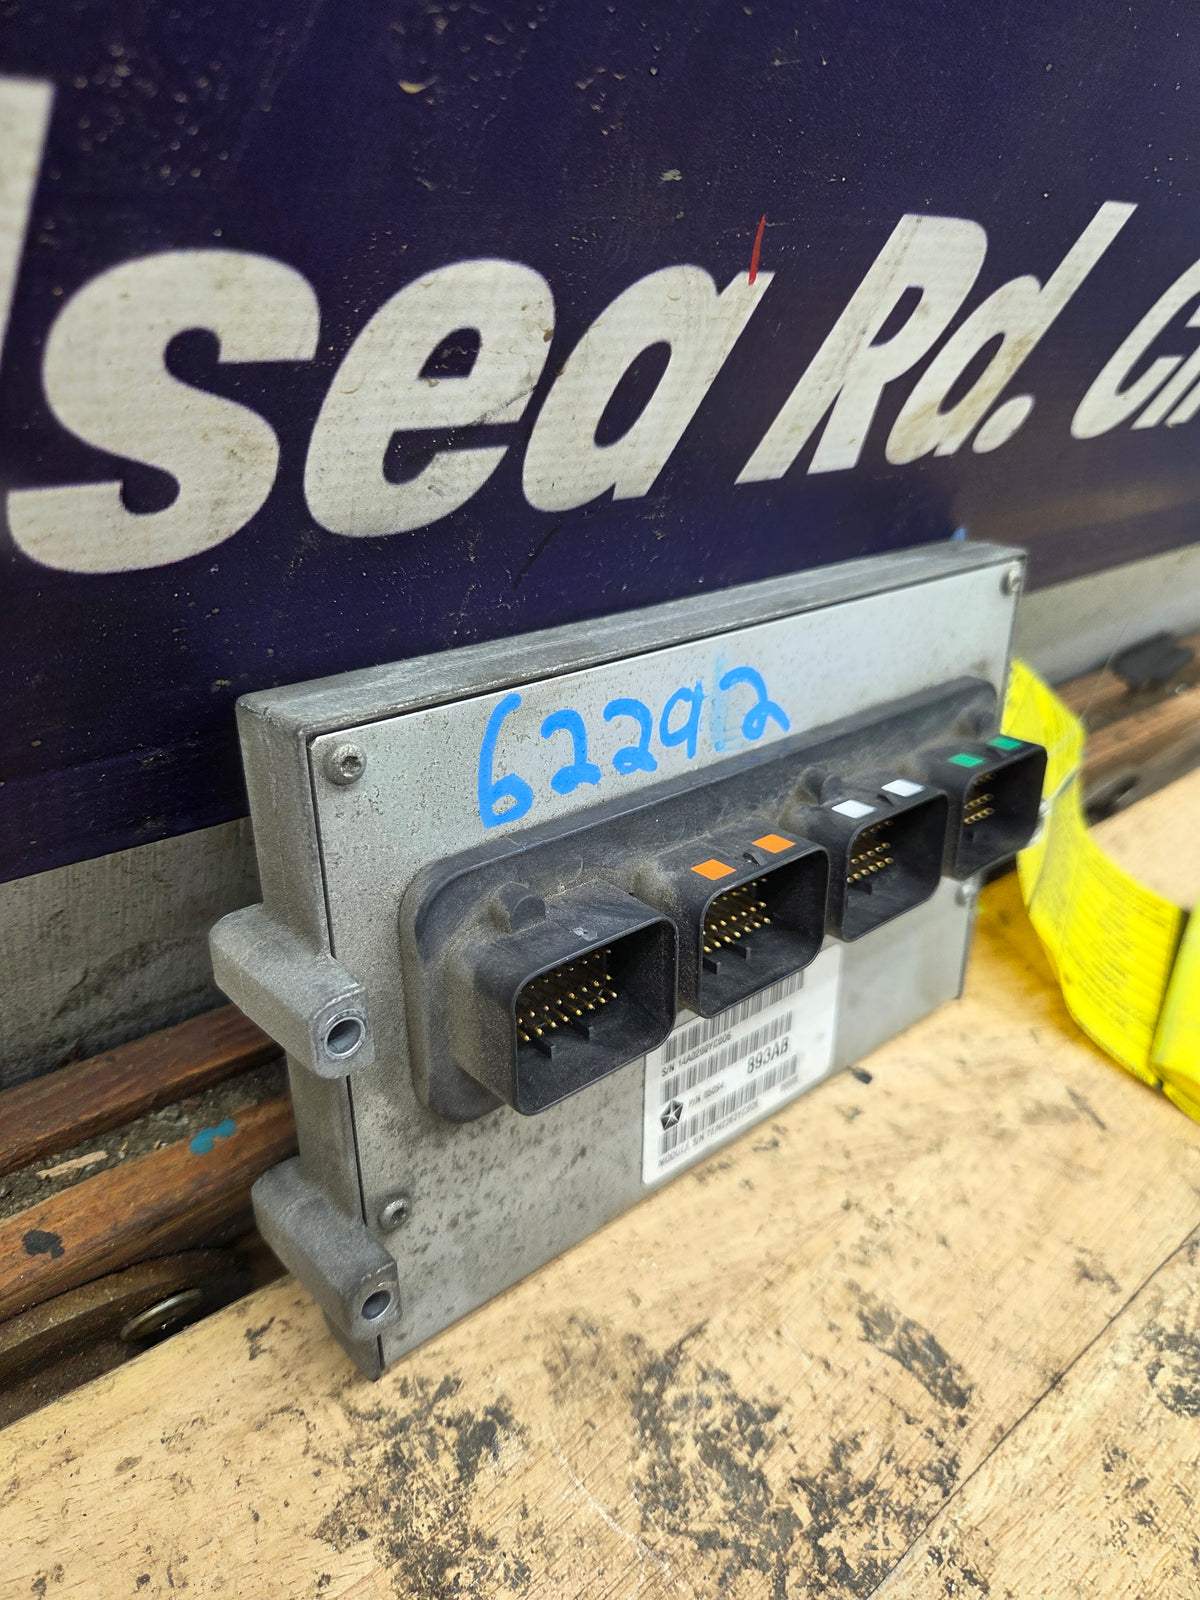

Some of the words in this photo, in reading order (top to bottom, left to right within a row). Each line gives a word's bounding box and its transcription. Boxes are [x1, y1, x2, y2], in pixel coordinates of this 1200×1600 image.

[734, 201, 1138, 485] Rd.
[478, 665, 790, 829] 62292
[746, 1036, 789, 1074] 893AB
